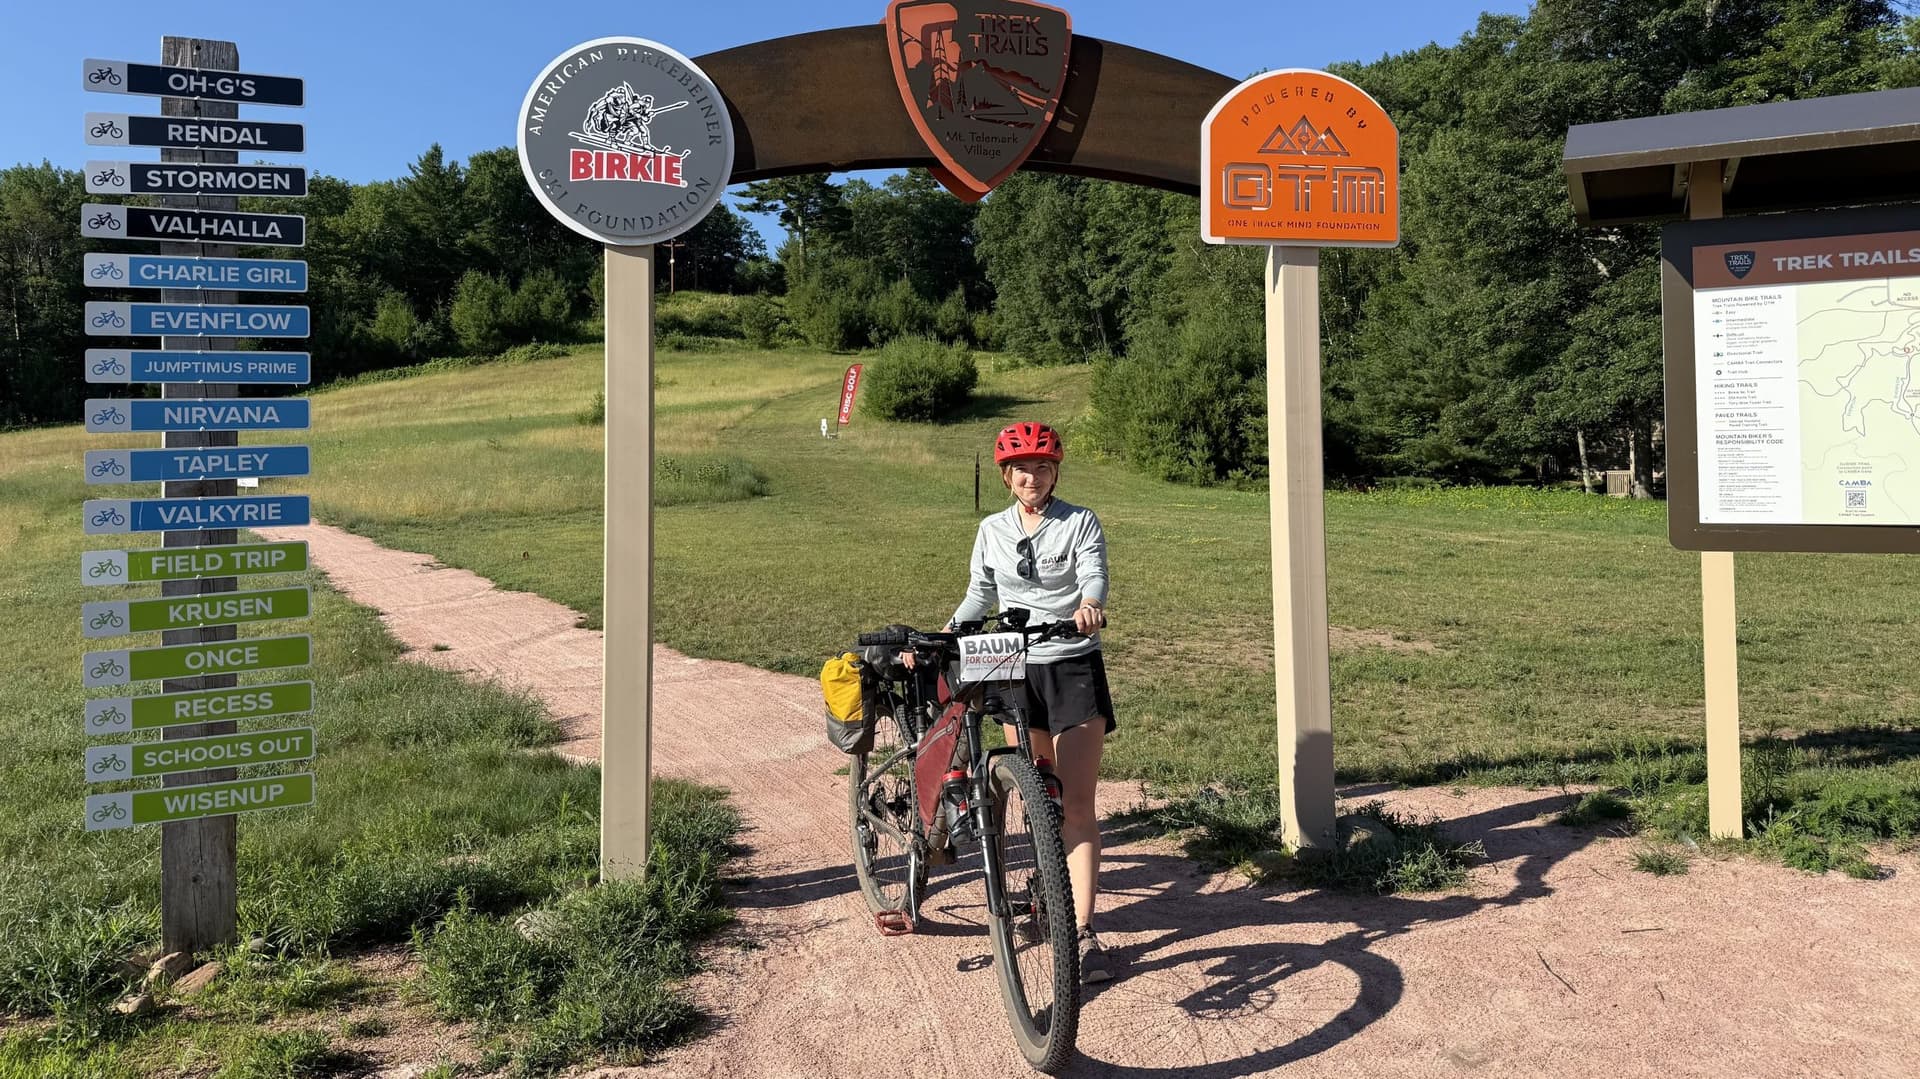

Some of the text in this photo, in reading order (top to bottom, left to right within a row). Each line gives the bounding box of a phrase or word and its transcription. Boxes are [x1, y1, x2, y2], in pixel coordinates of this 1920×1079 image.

[975, 13, 1042, 35] TREK
[968, 33, 1049, 57] TRAILS
[167, 73, 257, 97] OH-G'S
[528, 49, 605, 137] AMERICAN
[1240, 86, 1368, 130] POWERED BY
[167, 124, 268, 145] RENDAL
[968, 131, 1019, 145] Telemark
[964, 144, 1001, 159] Village
[569, 147, 685, 188] BIRKIE
[146, 170, 291, 190] STORMOEN
[538, 168, 712, 232] SKI FOUNDATION
[149, 214, 283, 239] VALHALLA
[1227, 219, 1249, 228] ONE
[1286, 221, 1313, 230] MIND
[1316, 222, 1381, 231] FOUNDATION
[1772, 247, 1920, 273] TREK TRAILS
[139, 263, 297, 284] CHARLIE GIRL
[150, 311, 292, 330] EVENFLOW
[144, 360, 297, 375] JUMPTIMUS PRIME
[164, 406, 281, 425] NIRVANA
[173, 453, 270, 474] TAPLEY
[158, 502, 282, 524] VALKYRIE
[151, 550, 287, 575] FIELD TRIP
[1041, 553, 1068, 565] BAUM
[168, 597, 273, 623] KRUSEN
[964, 637, 1020, 655] BAUM
[184, 646, 259, 670] ONCE
[965, 653, 1021, 665] FOR CONGRESS
[174, 692, 274, 719] RECESS
[143, 736, 304, 767] SCHOOL'S OUT
[163, 784, 285, 814] WISENUP
